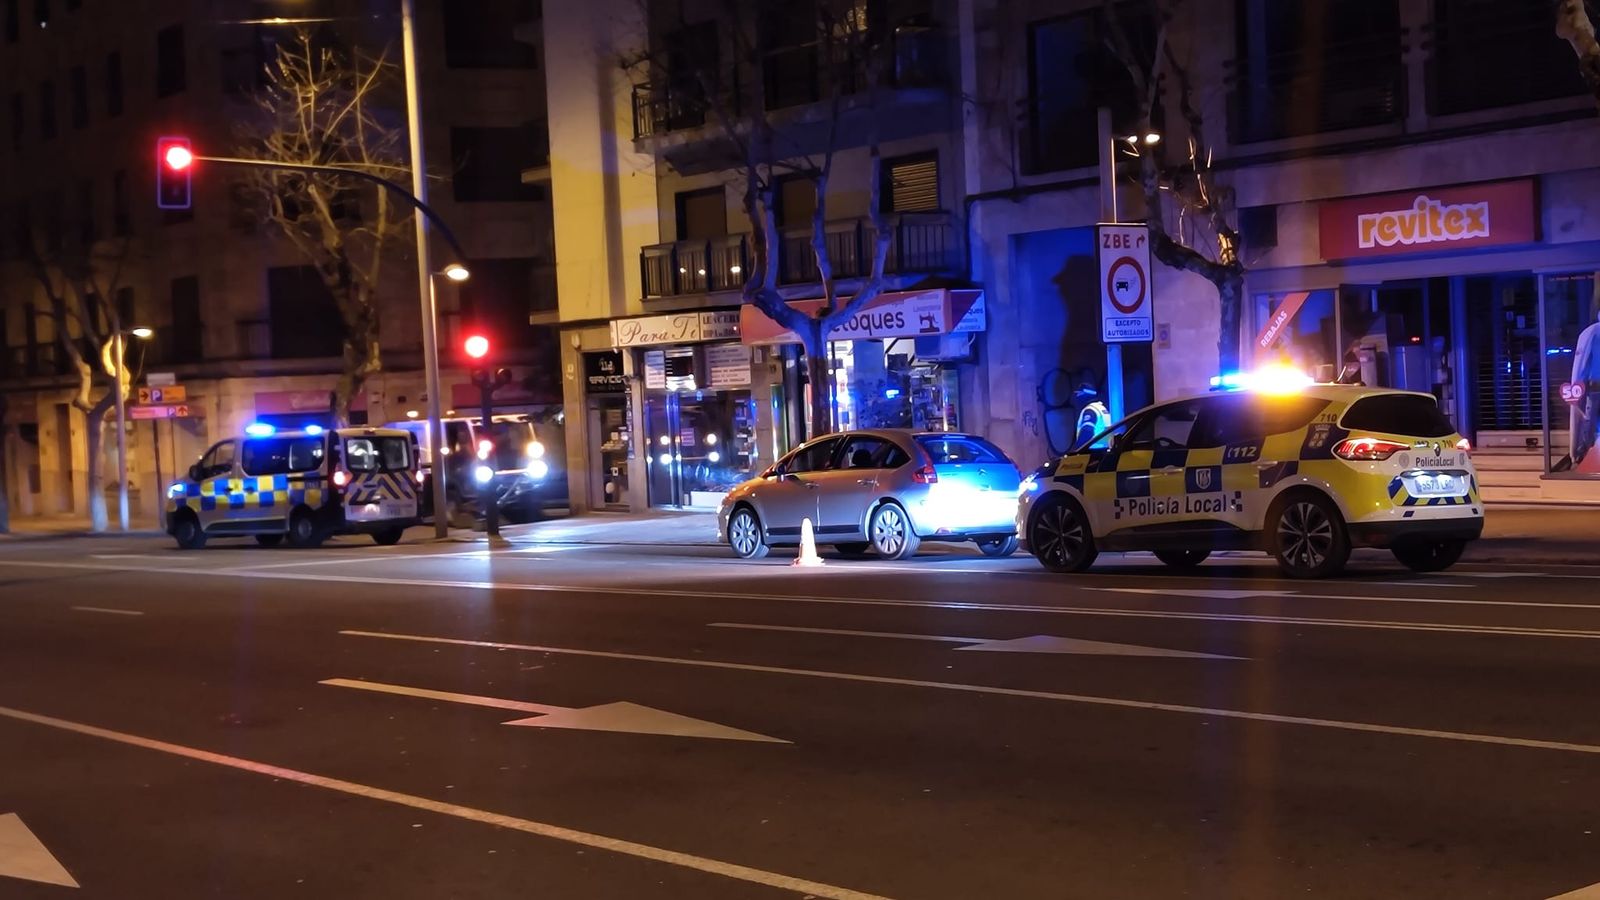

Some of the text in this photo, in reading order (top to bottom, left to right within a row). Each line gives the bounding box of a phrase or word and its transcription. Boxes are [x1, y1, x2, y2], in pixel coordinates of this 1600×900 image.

[1358, 196, 1489, 248] revitex
[1103, 233, 1131, 249] ZBE
[1115, 319, 1142, 328] EXCEPTO
[1260, 311, 1288, 348] REBAJAS
[620, 321, 670, 345] Para
[1107, 329, 1149, 338] AUTORIZADOS
[1562, 385, 1582, 399] 50
[1321, 413, 1337, 423] 710
[1128, 494, 1227, 516] Policía Local
